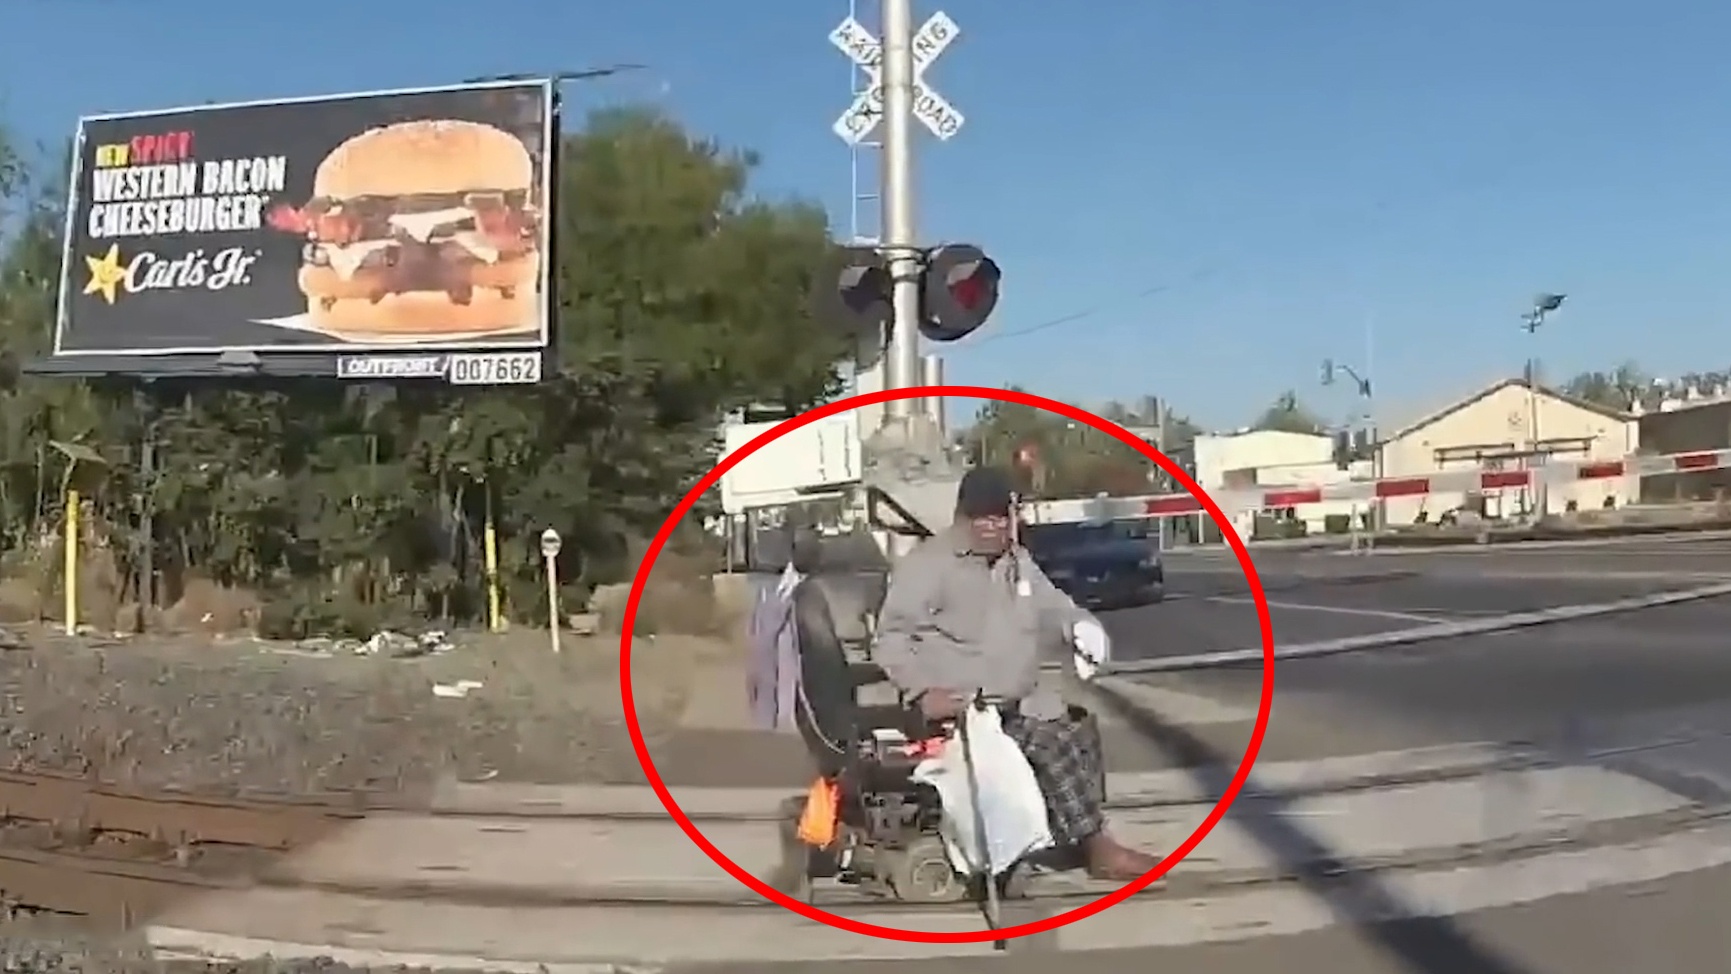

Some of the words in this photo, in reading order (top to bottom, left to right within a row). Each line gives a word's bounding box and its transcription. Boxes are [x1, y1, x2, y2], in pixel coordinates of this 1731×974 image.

[96, 143, 131, 167] NEW
[130, 130, 191, 163] SPICY
[93, 162, 197, 201] WESTERN
[202, 156, 286, 195] BACON
[88, 195, 263, 238] CHEESEBURGER
[124, 249, 208, 293] Carl's
[207, 246, 257, 290] Jr.
[455, 358, 536, 381] 007662
